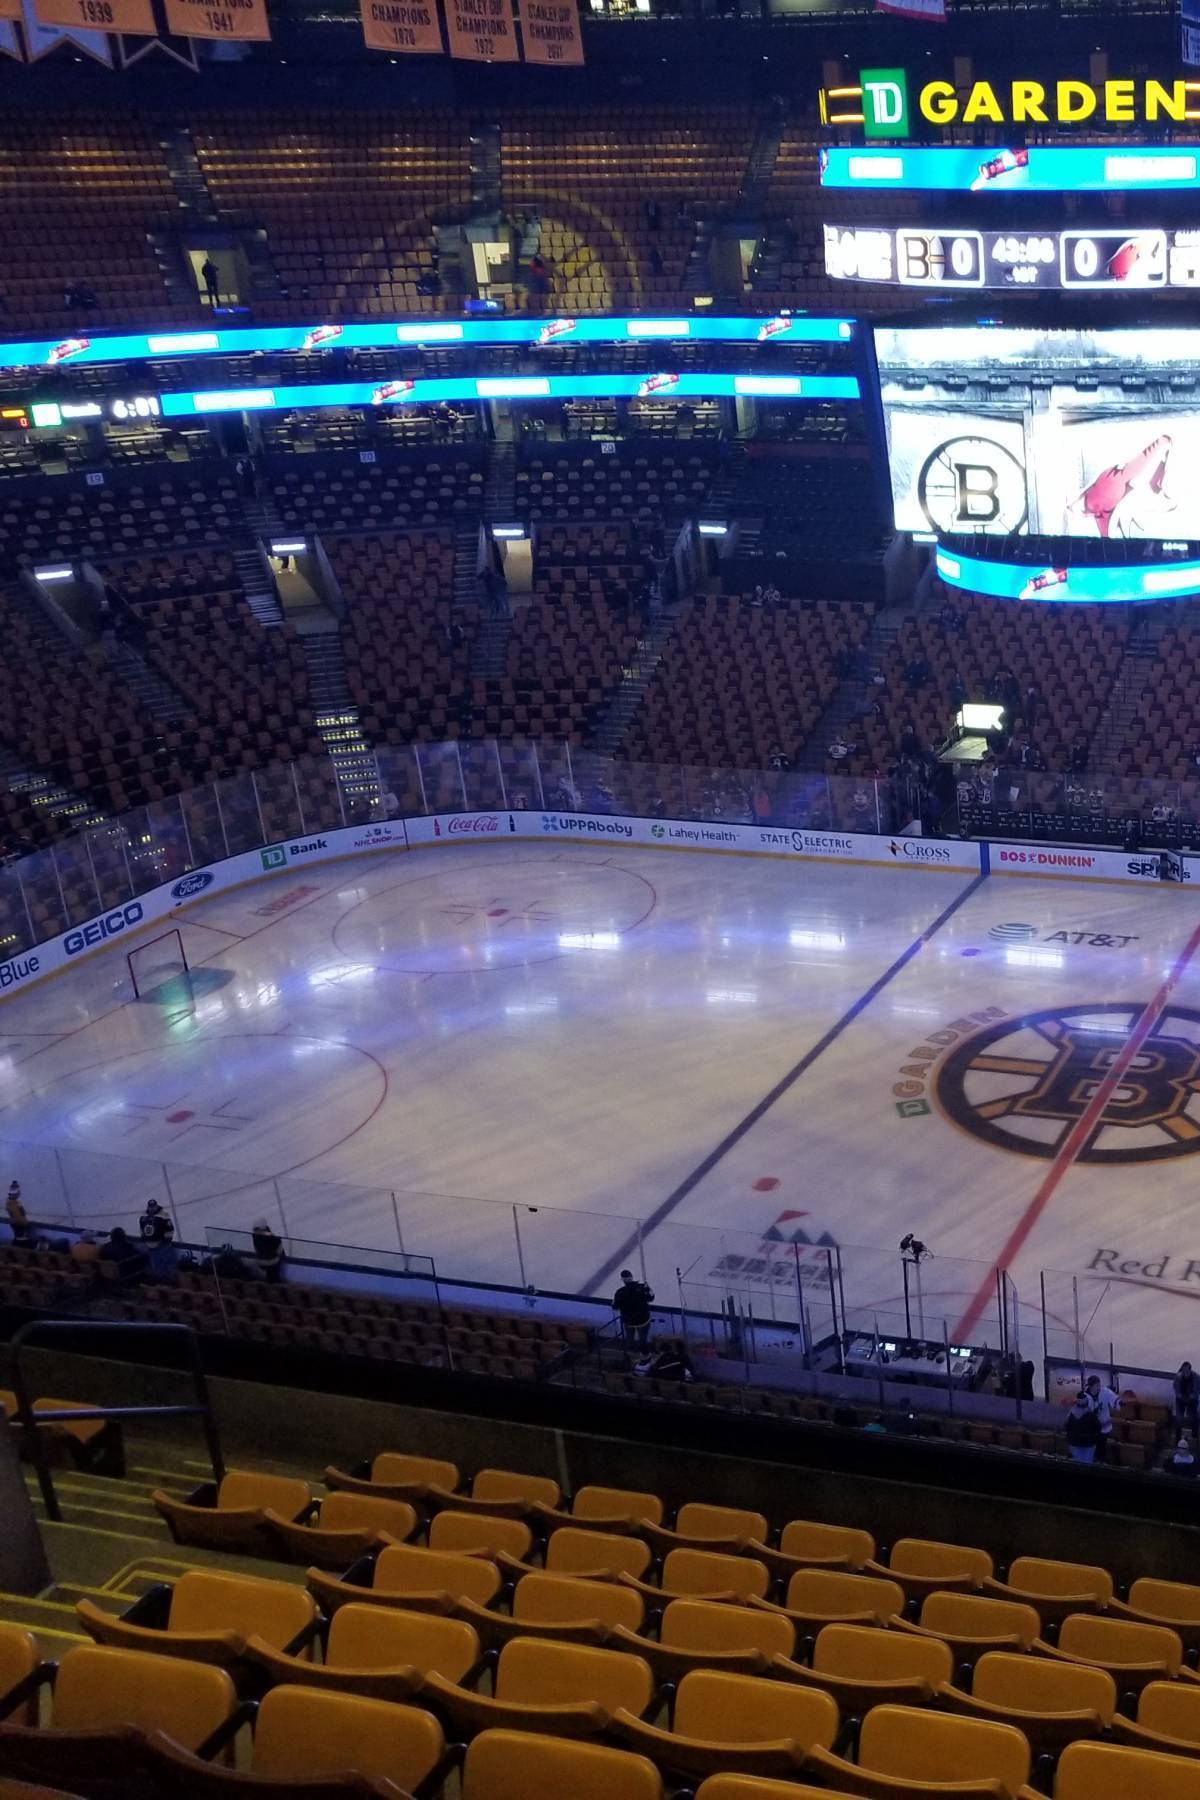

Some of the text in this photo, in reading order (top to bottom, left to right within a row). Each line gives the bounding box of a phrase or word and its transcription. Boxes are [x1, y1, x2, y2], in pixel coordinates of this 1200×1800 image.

[206, 12, 235, 32] 1941
[371, 4, 432, 26] CHAMPIONS
[456, 16, 508, 36] CHAMPIONS
[529, 25, 575, 41] CHAMPIONS
[864, 81, 903, 124] TD
[918, 80, 1188, 124] GARDEN
[953, 462, 1001, 522] B
[559, 819, 633, 837] UPPAbaby
[668, 828, 736, 842] Lahey Health
[289, 839, 328, 855] Bank
[760, 833, 790, 844] STATE
[804, 838, 853, 849] ELECTRIC
[999, 851, 1096, 868] BOS DUNKIN'
[63, 902, 144, 956] GEICO
[1044, 930, 1140, 949] AT&T
[0, 956, 40, 989] Blue
[892, 1006, 1009, 1098] GARDEN
[1085, 1248, 1170, 1279] Red
